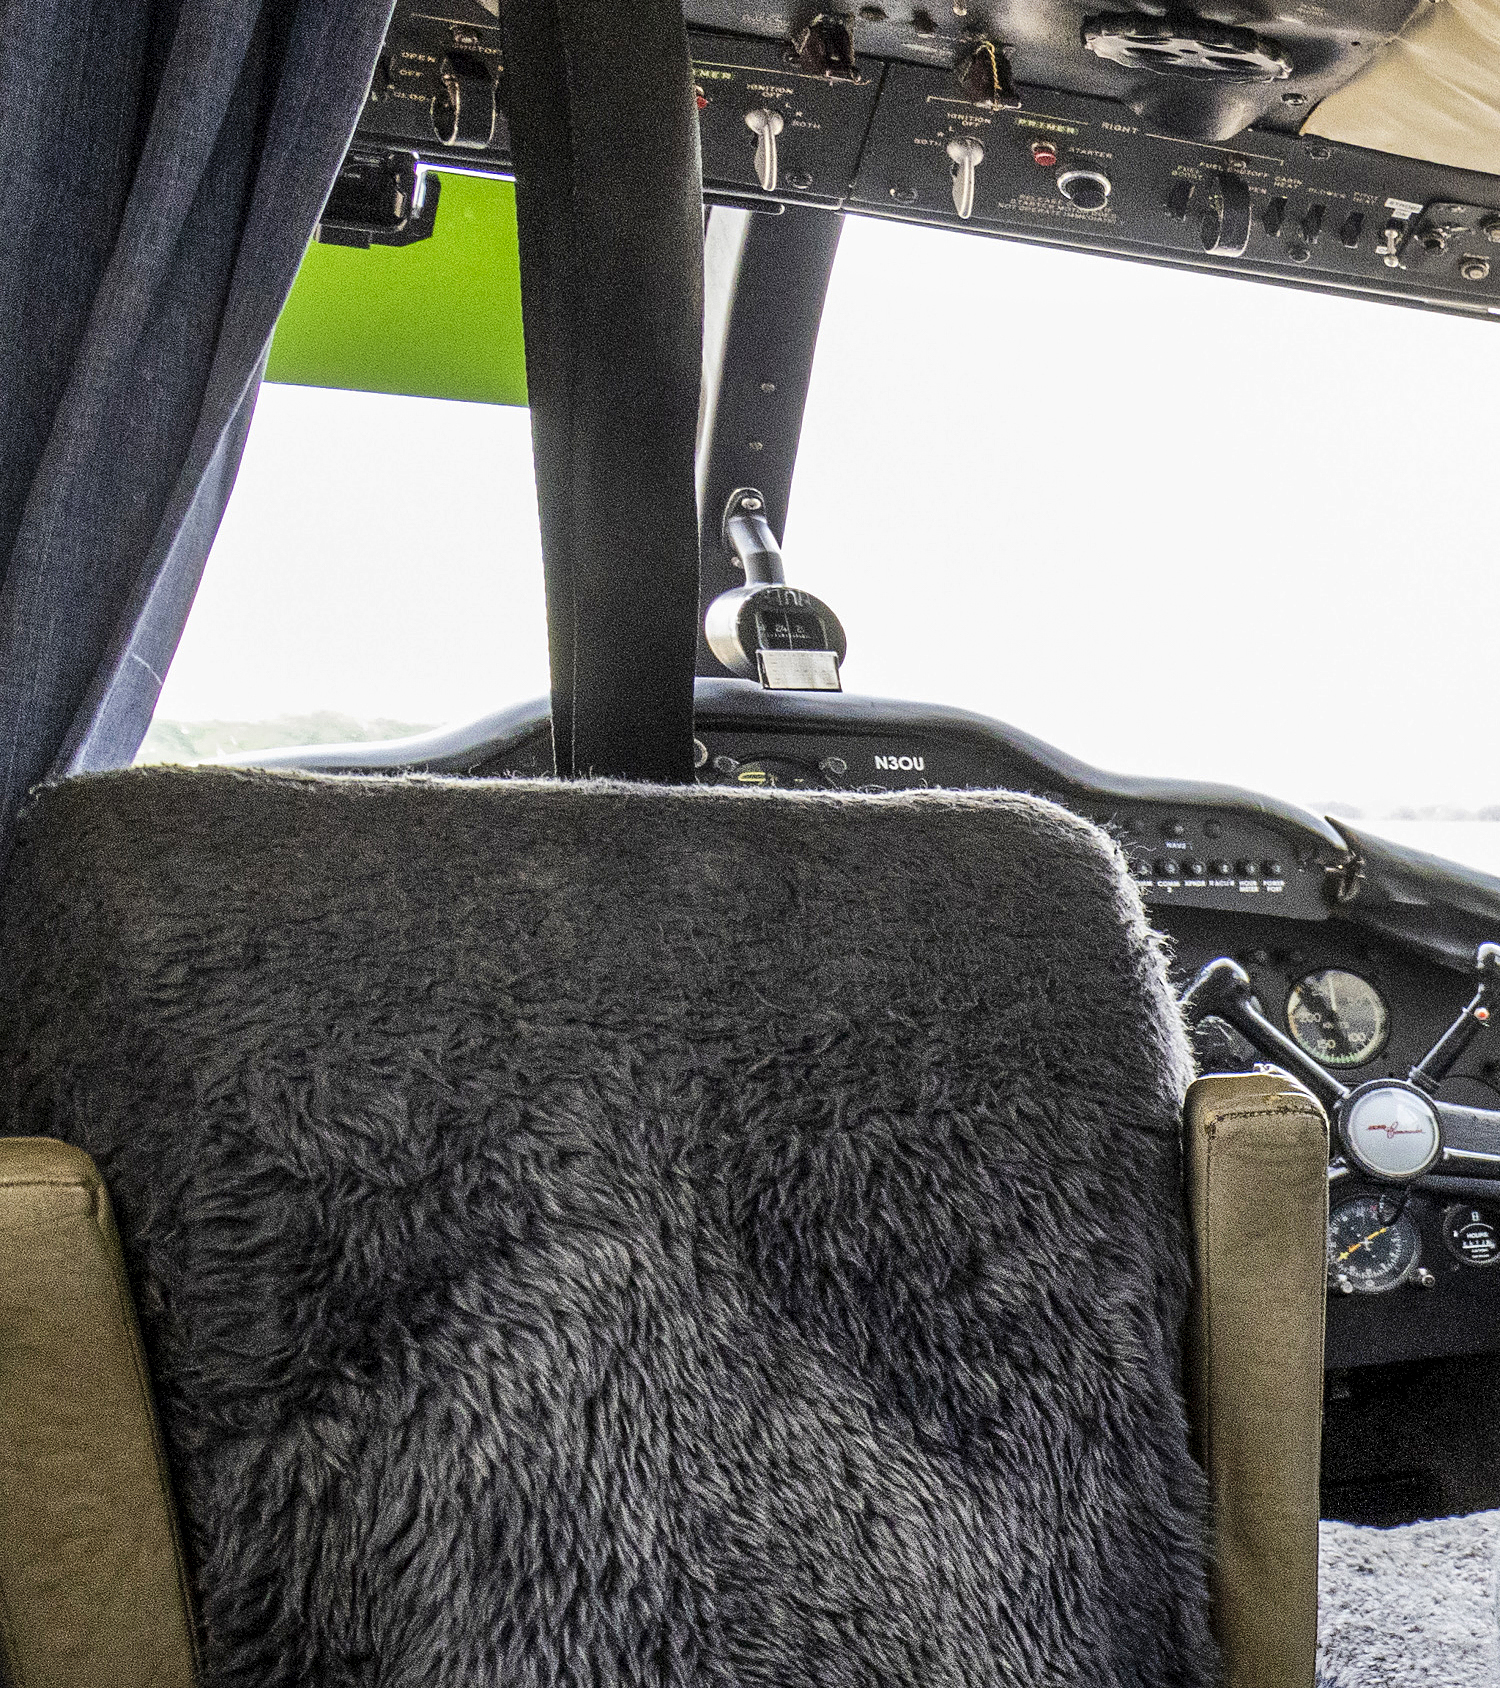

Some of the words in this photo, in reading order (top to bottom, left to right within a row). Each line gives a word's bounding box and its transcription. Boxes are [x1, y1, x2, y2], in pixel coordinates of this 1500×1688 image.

[401, 51, 437, 63] OPEN
[692, 68, 732, 79] IMER
[747, 83, 794, 95] IGNITION
[947, 112, 992, 125] IGNITION
[1017, 117, 1077, 135] PRIMER
[1101, 121, 1140, 135] RIGHT
[1068, 147, 1114, 159] STARTER
[1249, 185, 1268, 195] PEN
[1466, 1230, 1489, 1239] HOURS
